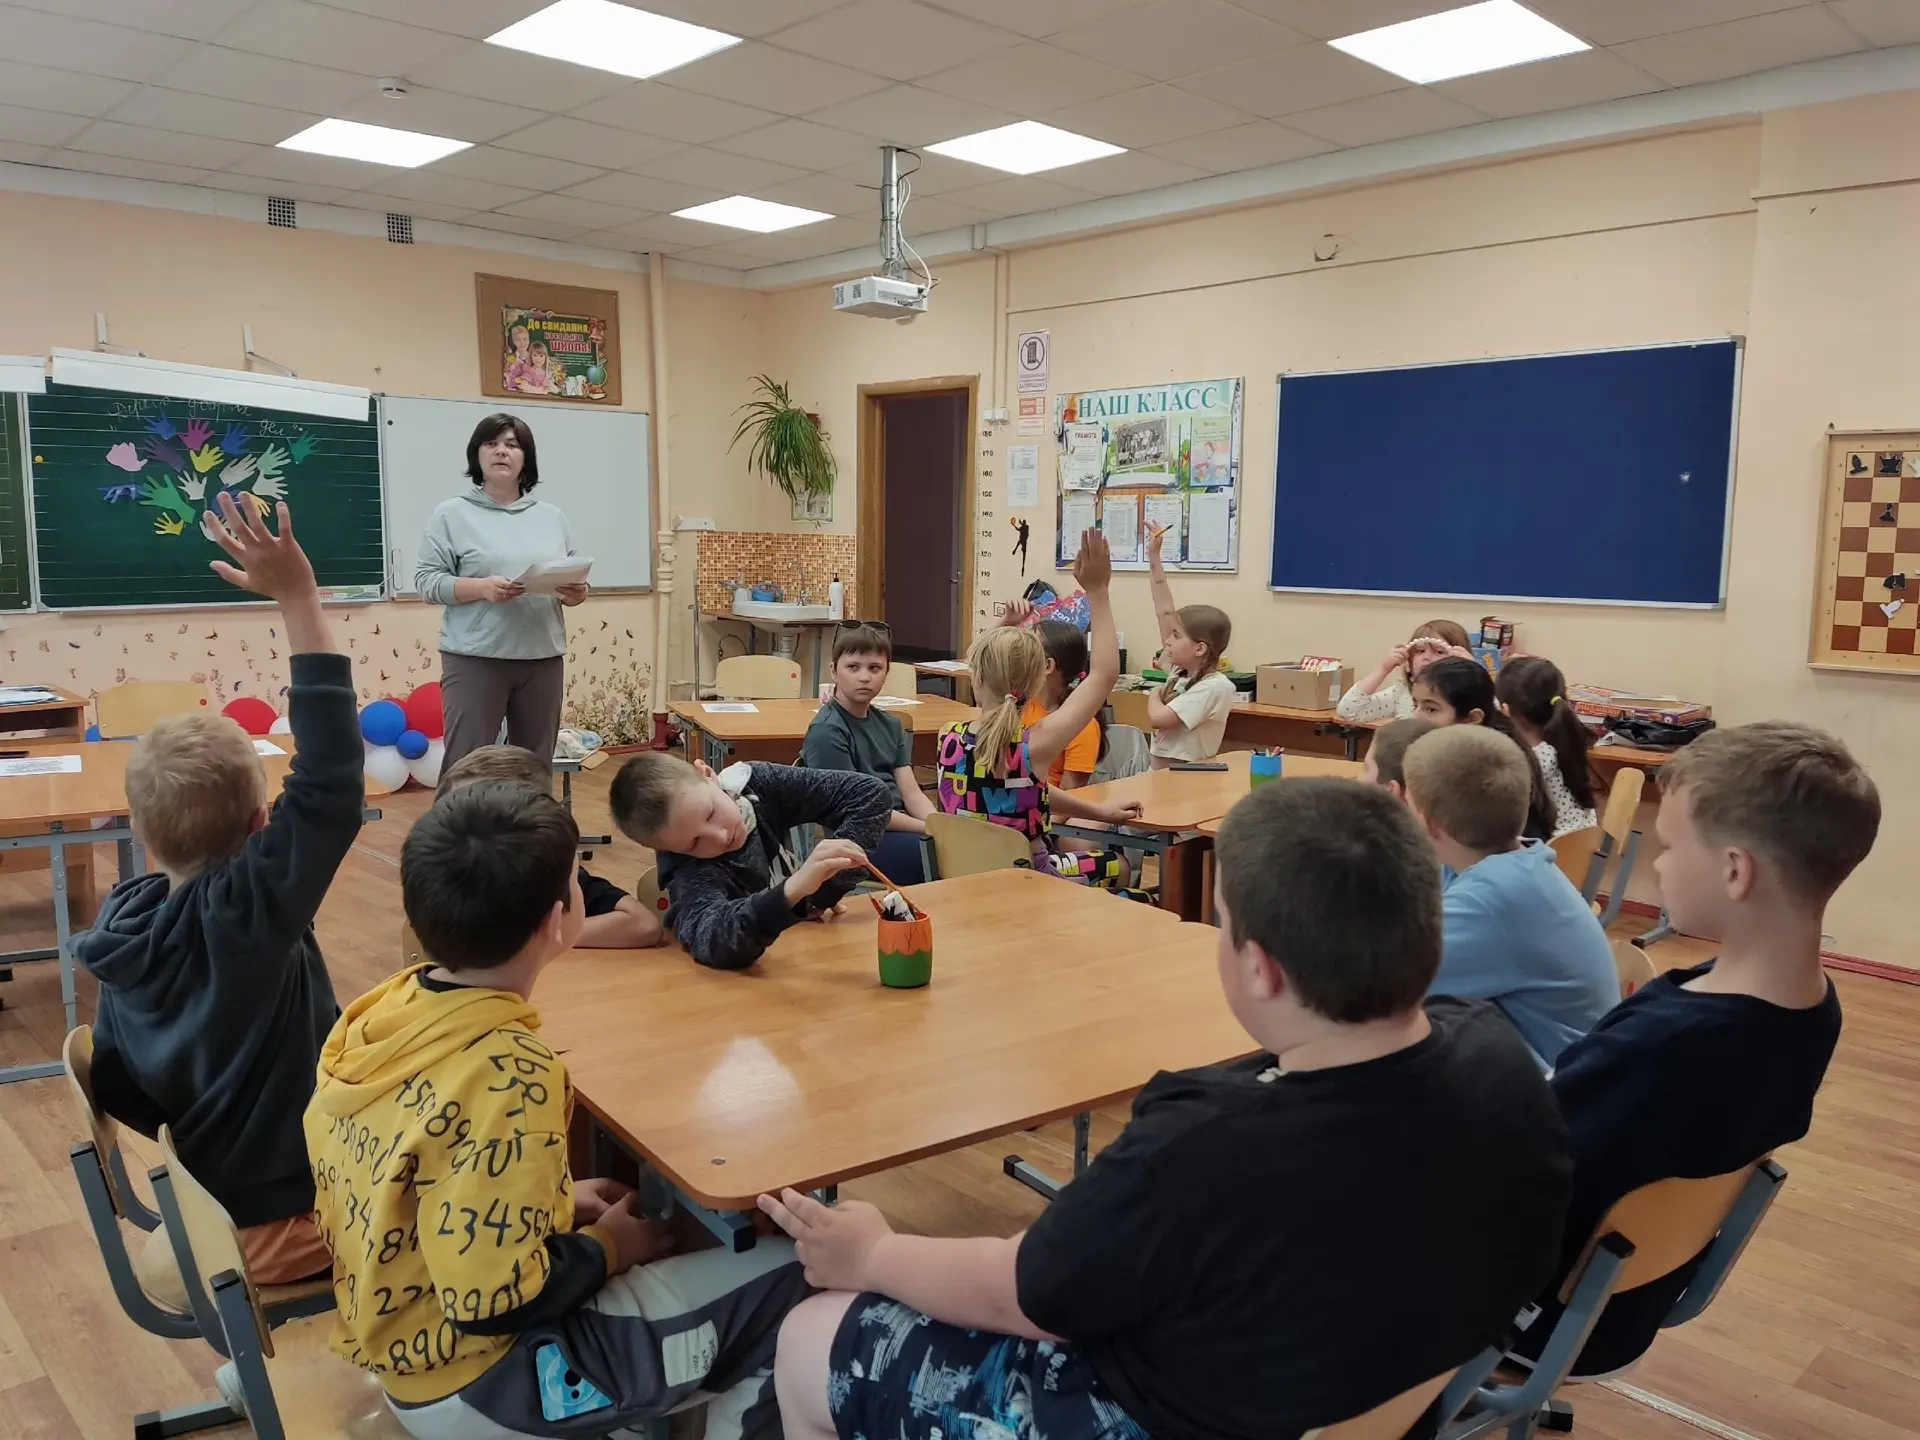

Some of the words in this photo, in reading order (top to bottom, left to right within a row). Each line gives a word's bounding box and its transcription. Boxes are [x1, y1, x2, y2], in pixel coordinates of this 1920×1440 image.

[1078, 394, 1130, 418] НАШ
[1137, 386, 1218, 414] КЛАСС
[981, 550, 992, 558] 120
